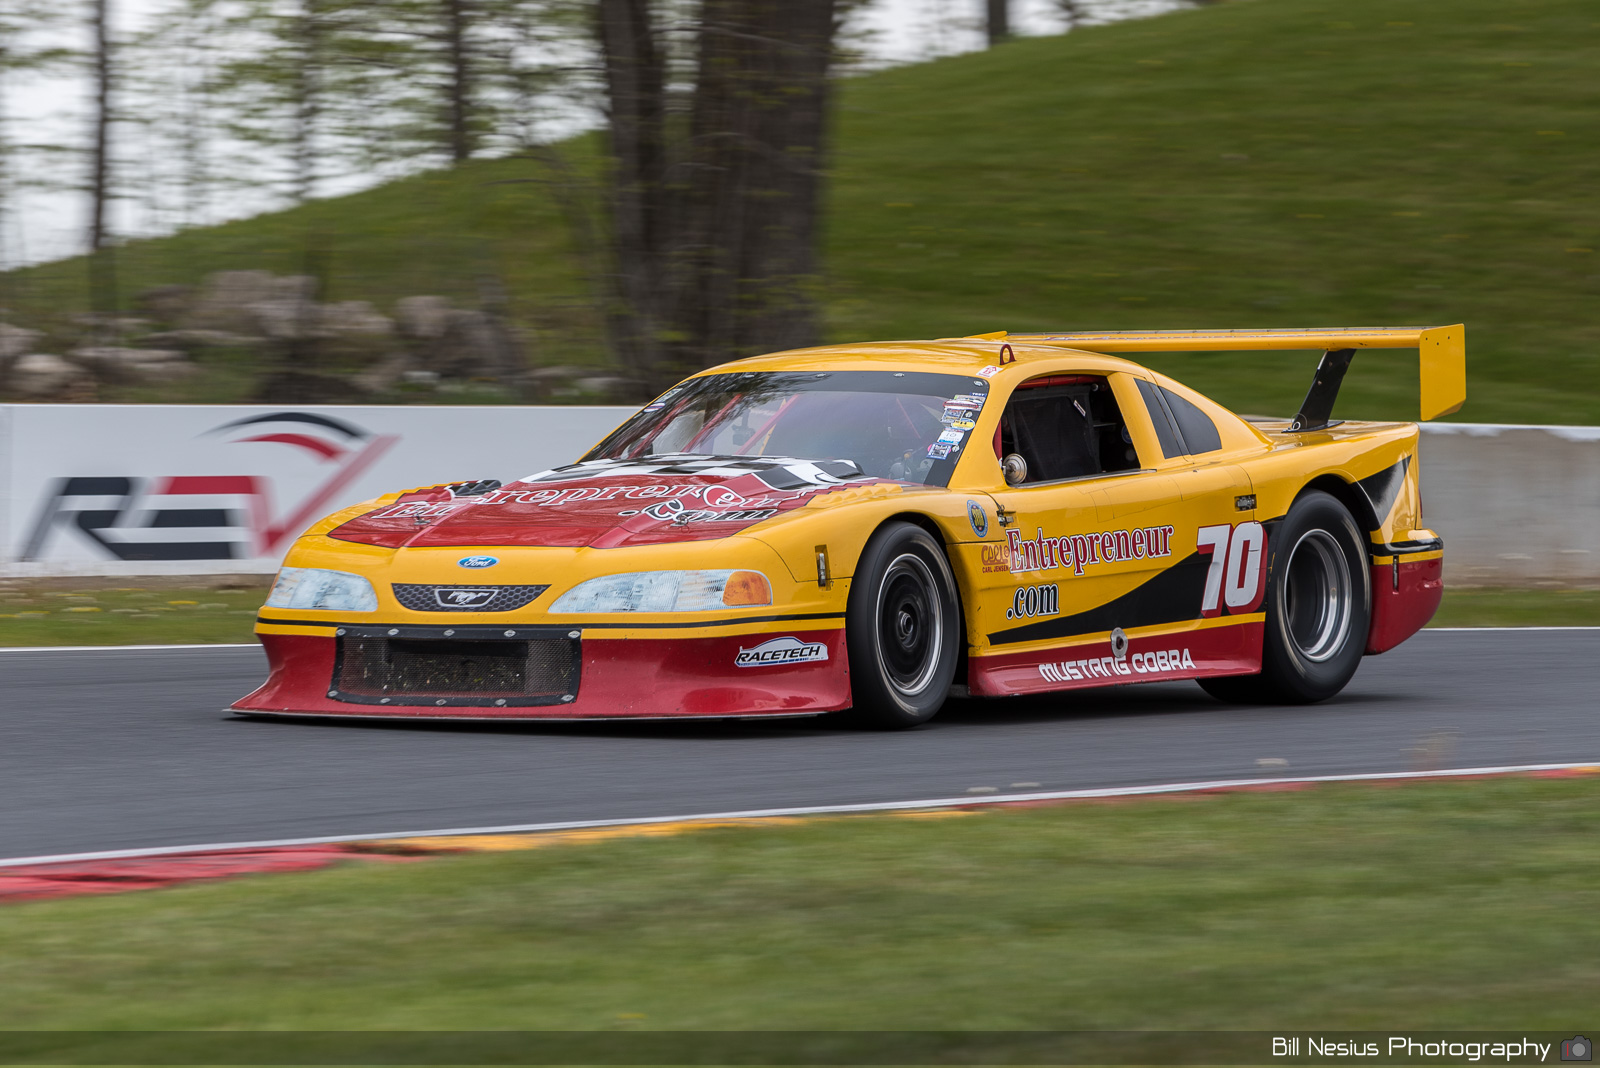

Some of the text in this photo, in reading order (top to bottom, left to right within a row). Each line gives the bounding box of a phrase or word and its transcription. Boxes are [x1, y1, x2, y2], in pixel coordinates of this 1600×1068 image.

[463, 557, 493, 567] Ford
[1005, 525, 1175, 576] Entrepreneur
[1197, 520, 1269, 619] 70
[1006, 583, 1059, 620] .com
[737, 645, 821, 663] RACETECH
[1038, 648, 1197, 682] MUSTANG COBRA
